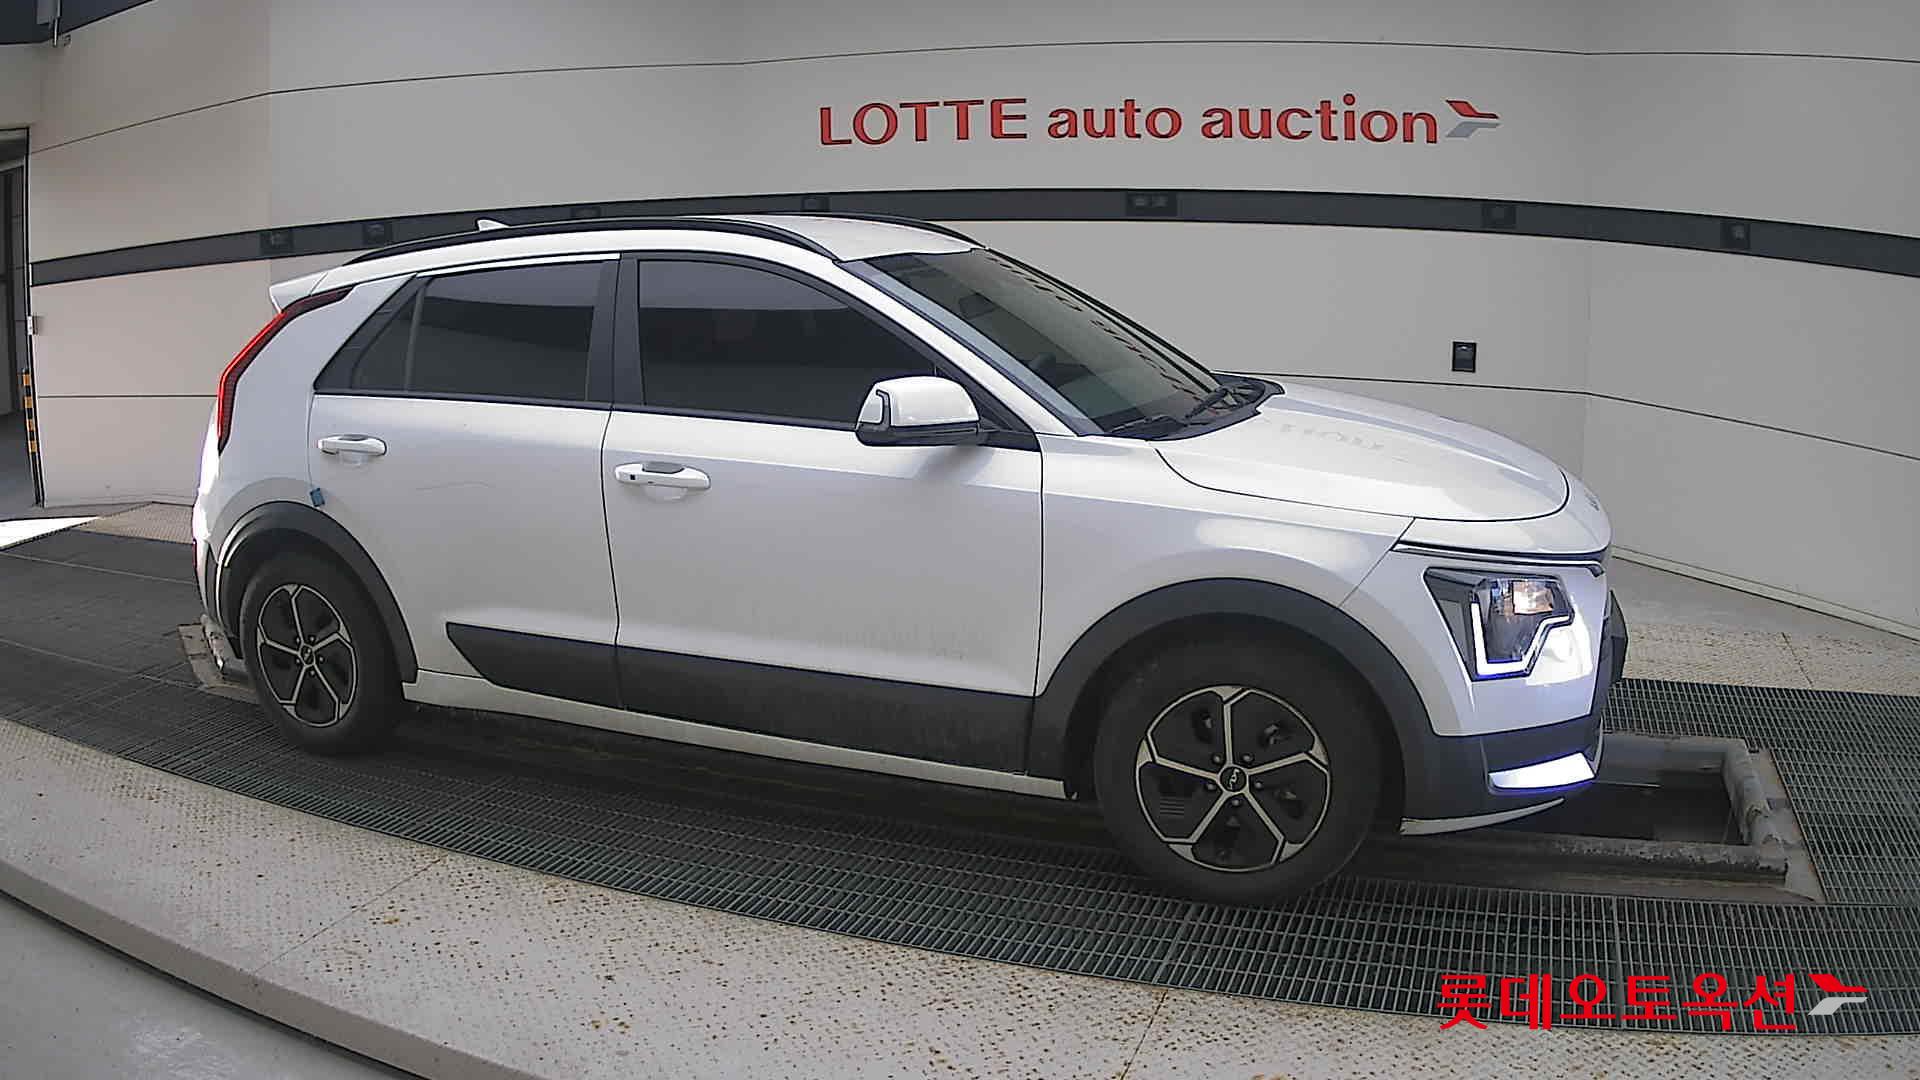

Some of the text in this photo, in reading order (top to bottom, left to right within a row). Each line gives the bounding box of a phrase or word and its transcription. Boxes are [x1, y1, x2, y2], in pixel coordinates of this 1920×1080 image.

[819, 93, 1438, 145] LOTTE auto auction
